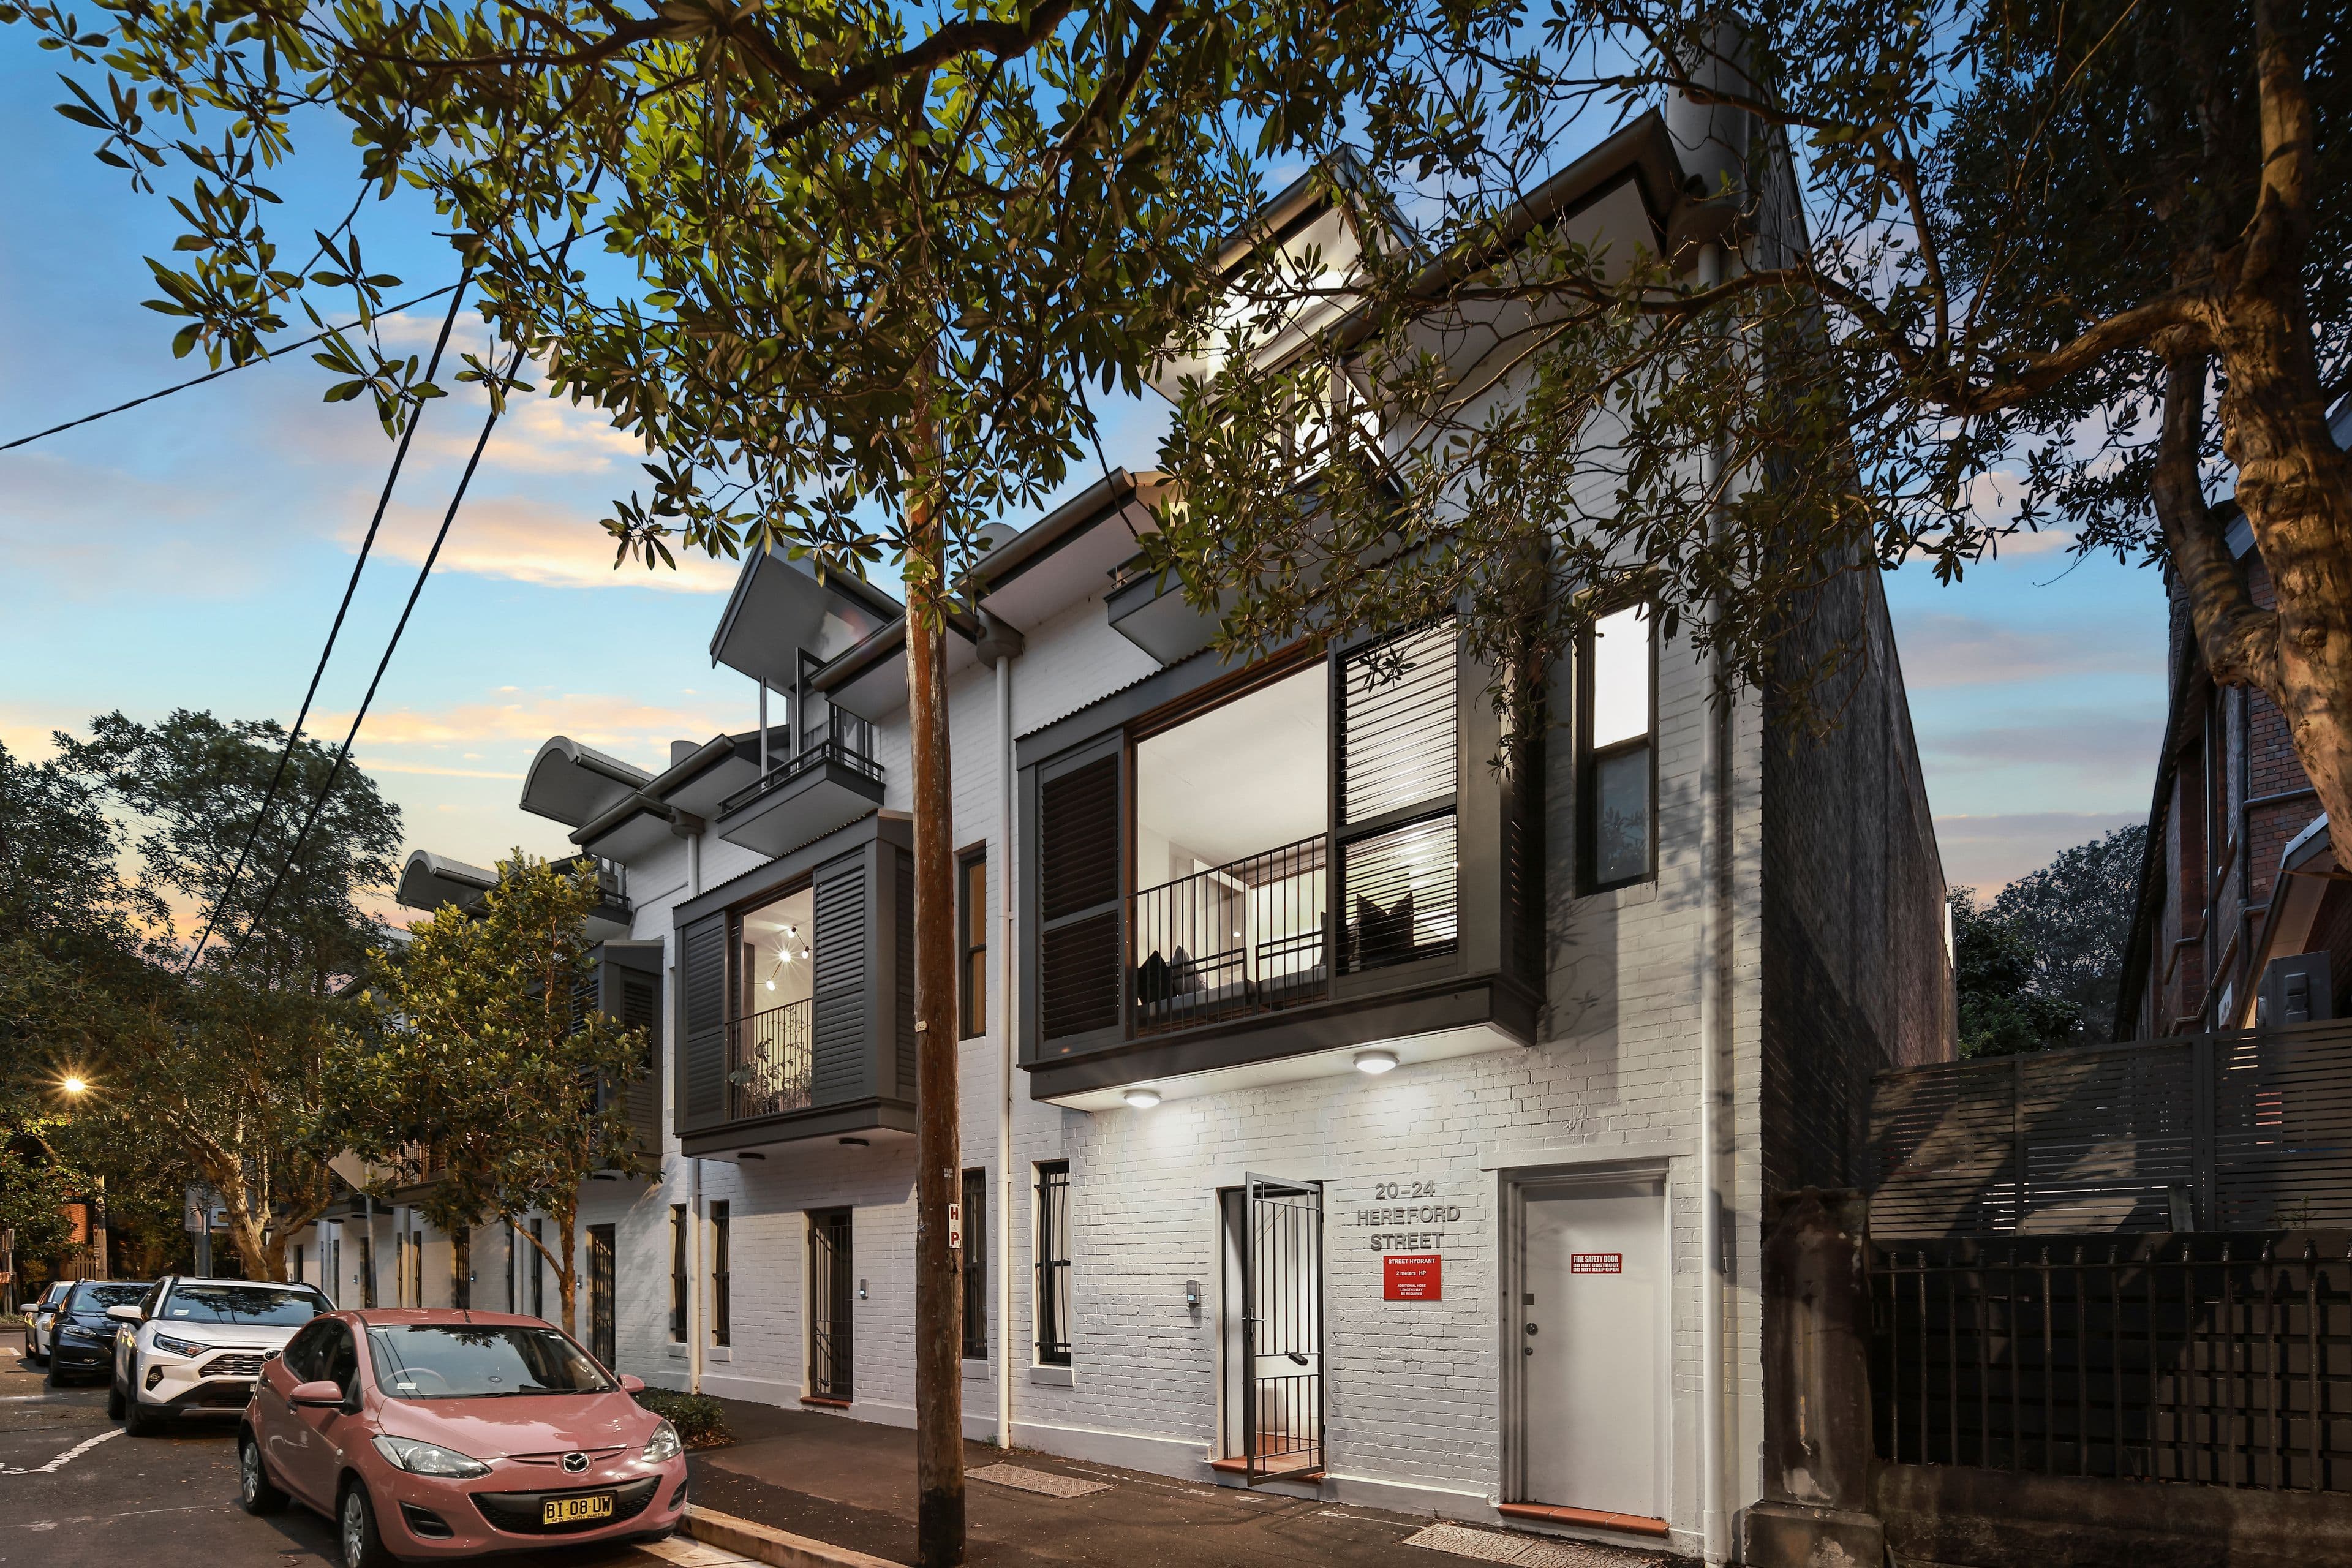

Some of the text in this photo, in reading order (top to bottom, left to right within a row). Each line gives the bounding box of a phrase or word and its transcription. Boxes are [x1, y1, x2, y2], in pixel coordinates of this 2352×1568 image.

[1376, 1180, 1435, 1200] 20-24
[1357, 1204, 1460, 1226] HEREFORD
[1370, 1231, 1444, 1251] STREET
